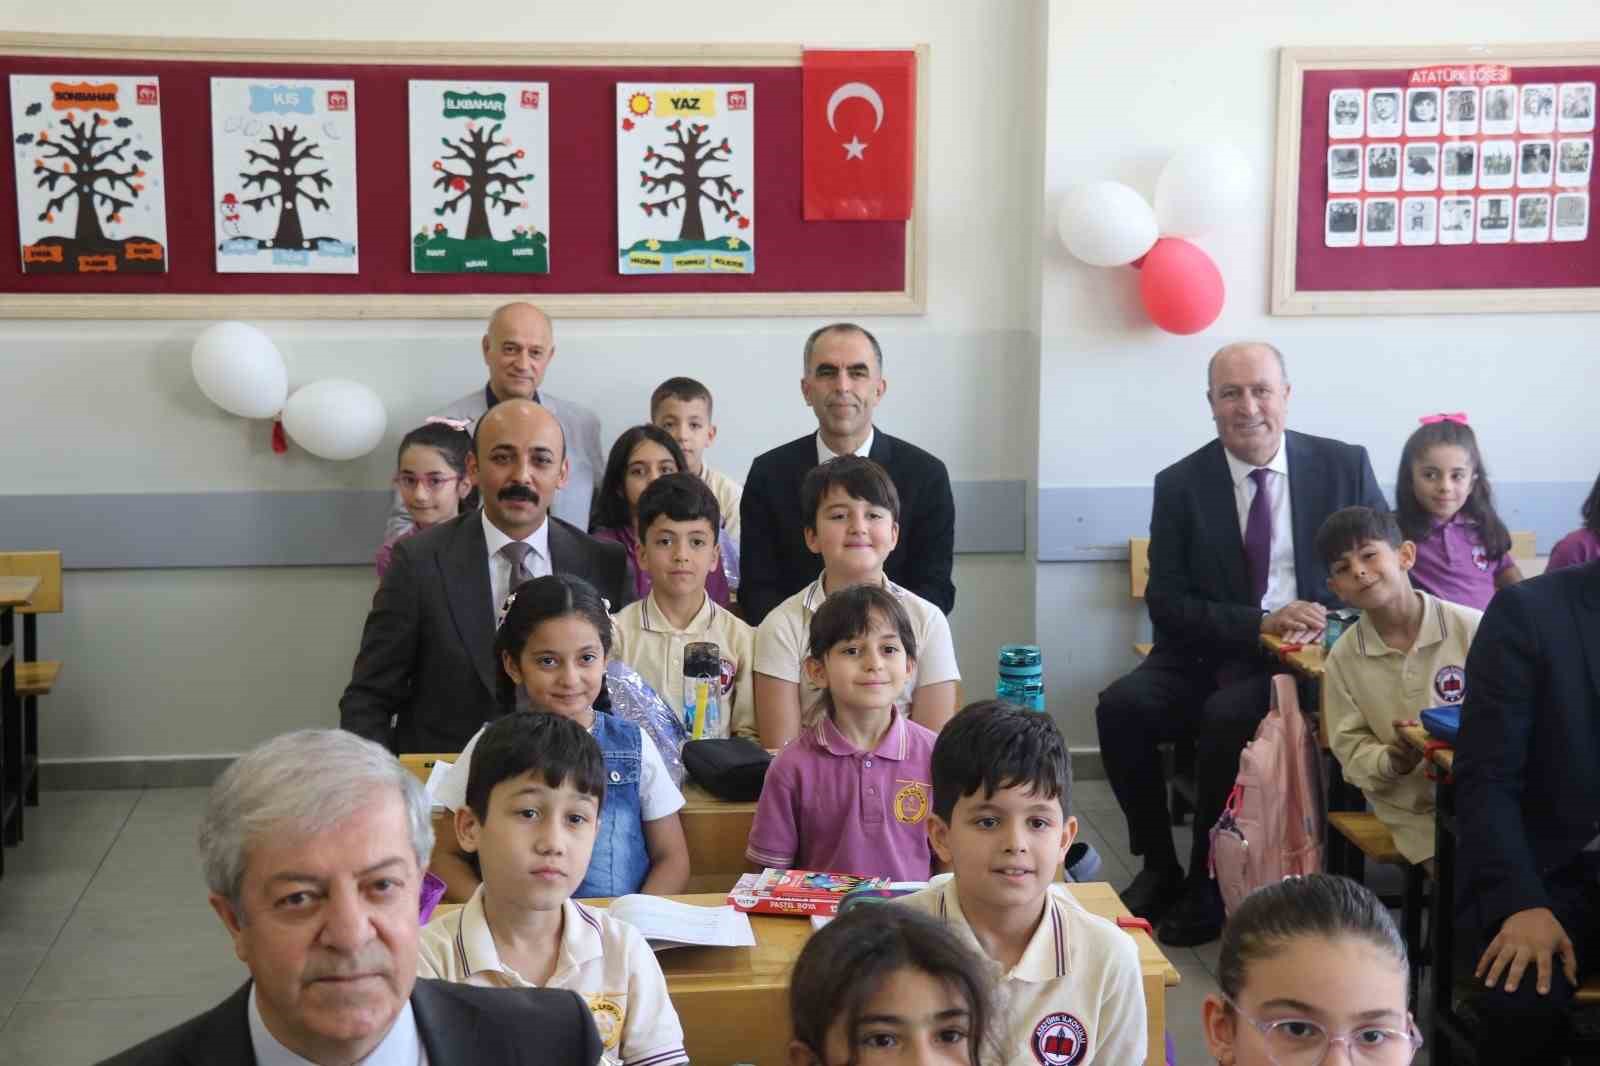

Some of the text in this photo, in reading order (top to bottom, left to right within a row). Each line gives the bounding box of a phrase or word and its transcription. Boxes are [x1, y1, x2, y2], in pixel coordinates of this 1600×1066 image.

[54, 91, 116, 102] SONBAHAR
[670, 97, 701, 110] YAZ
[769, 901, 795, 910] PASTEL
[796, 902, 817, 911] BOYA
